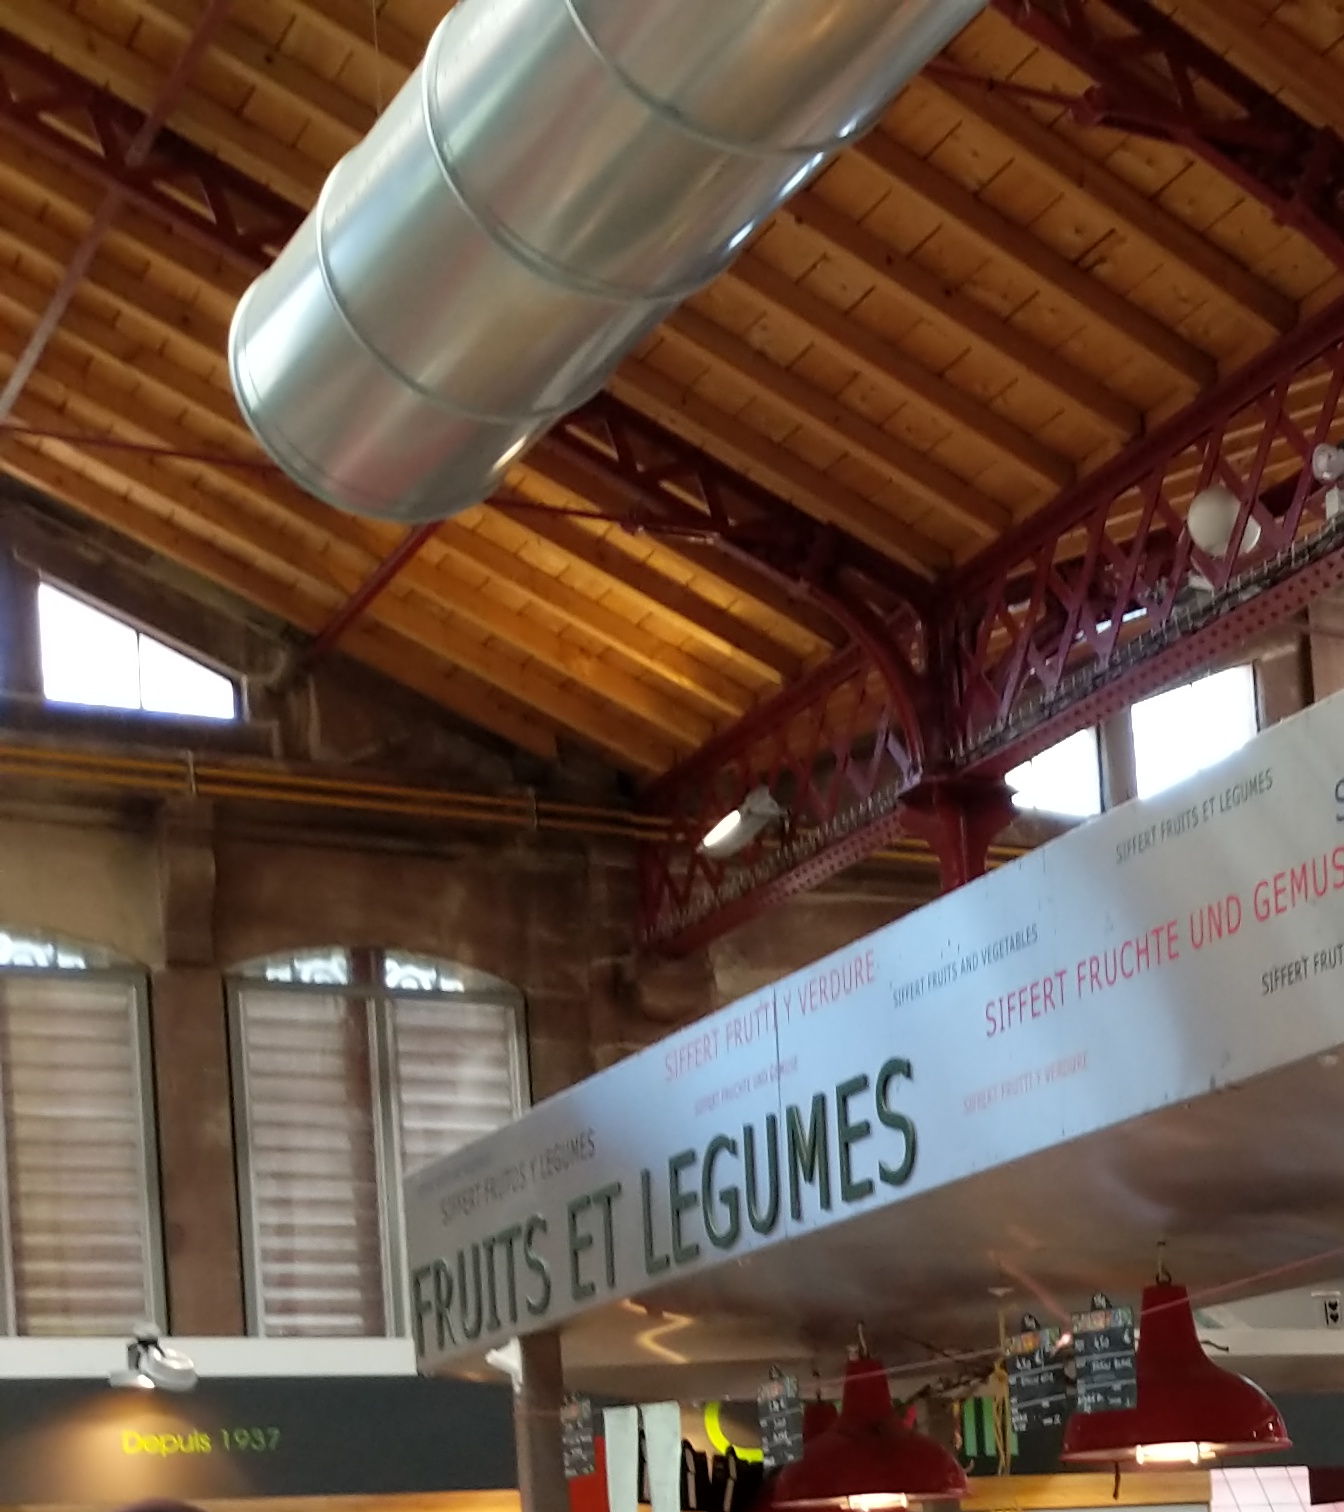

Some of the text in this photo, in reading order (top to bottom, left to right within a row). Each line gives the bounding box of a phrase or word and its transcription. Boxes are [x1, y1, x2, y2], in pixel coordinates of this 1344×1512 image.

[1116, 768, 1273, 864] SIFFERT FRUITS ET LEGUMES
[928, 964, 957, 991] FRUITS
[961, 954, 979, 975] AND
[981, 923, 1038, 966] VEGETABLES
[986, 968, 1067, 1038] SIFFERT
[1077, 920, 1179, 990] FRUCHTE
[1190, 894, 1241, 951] UND
[1262, 954, 1309, 996] SIFFERT
[665, 1028, 720, 1082] SIFFERT
[784, 989, 792, 1024] Y
[798, 949, 875, 1016] VERDURE
[411, 1214, 552, 1358] FRUITS
[566, 1182, 622, 1300] ET
[641, 1057, 918, 1276] LEGUMES
[121, 1426, 282, 1457] Depuis 1937
